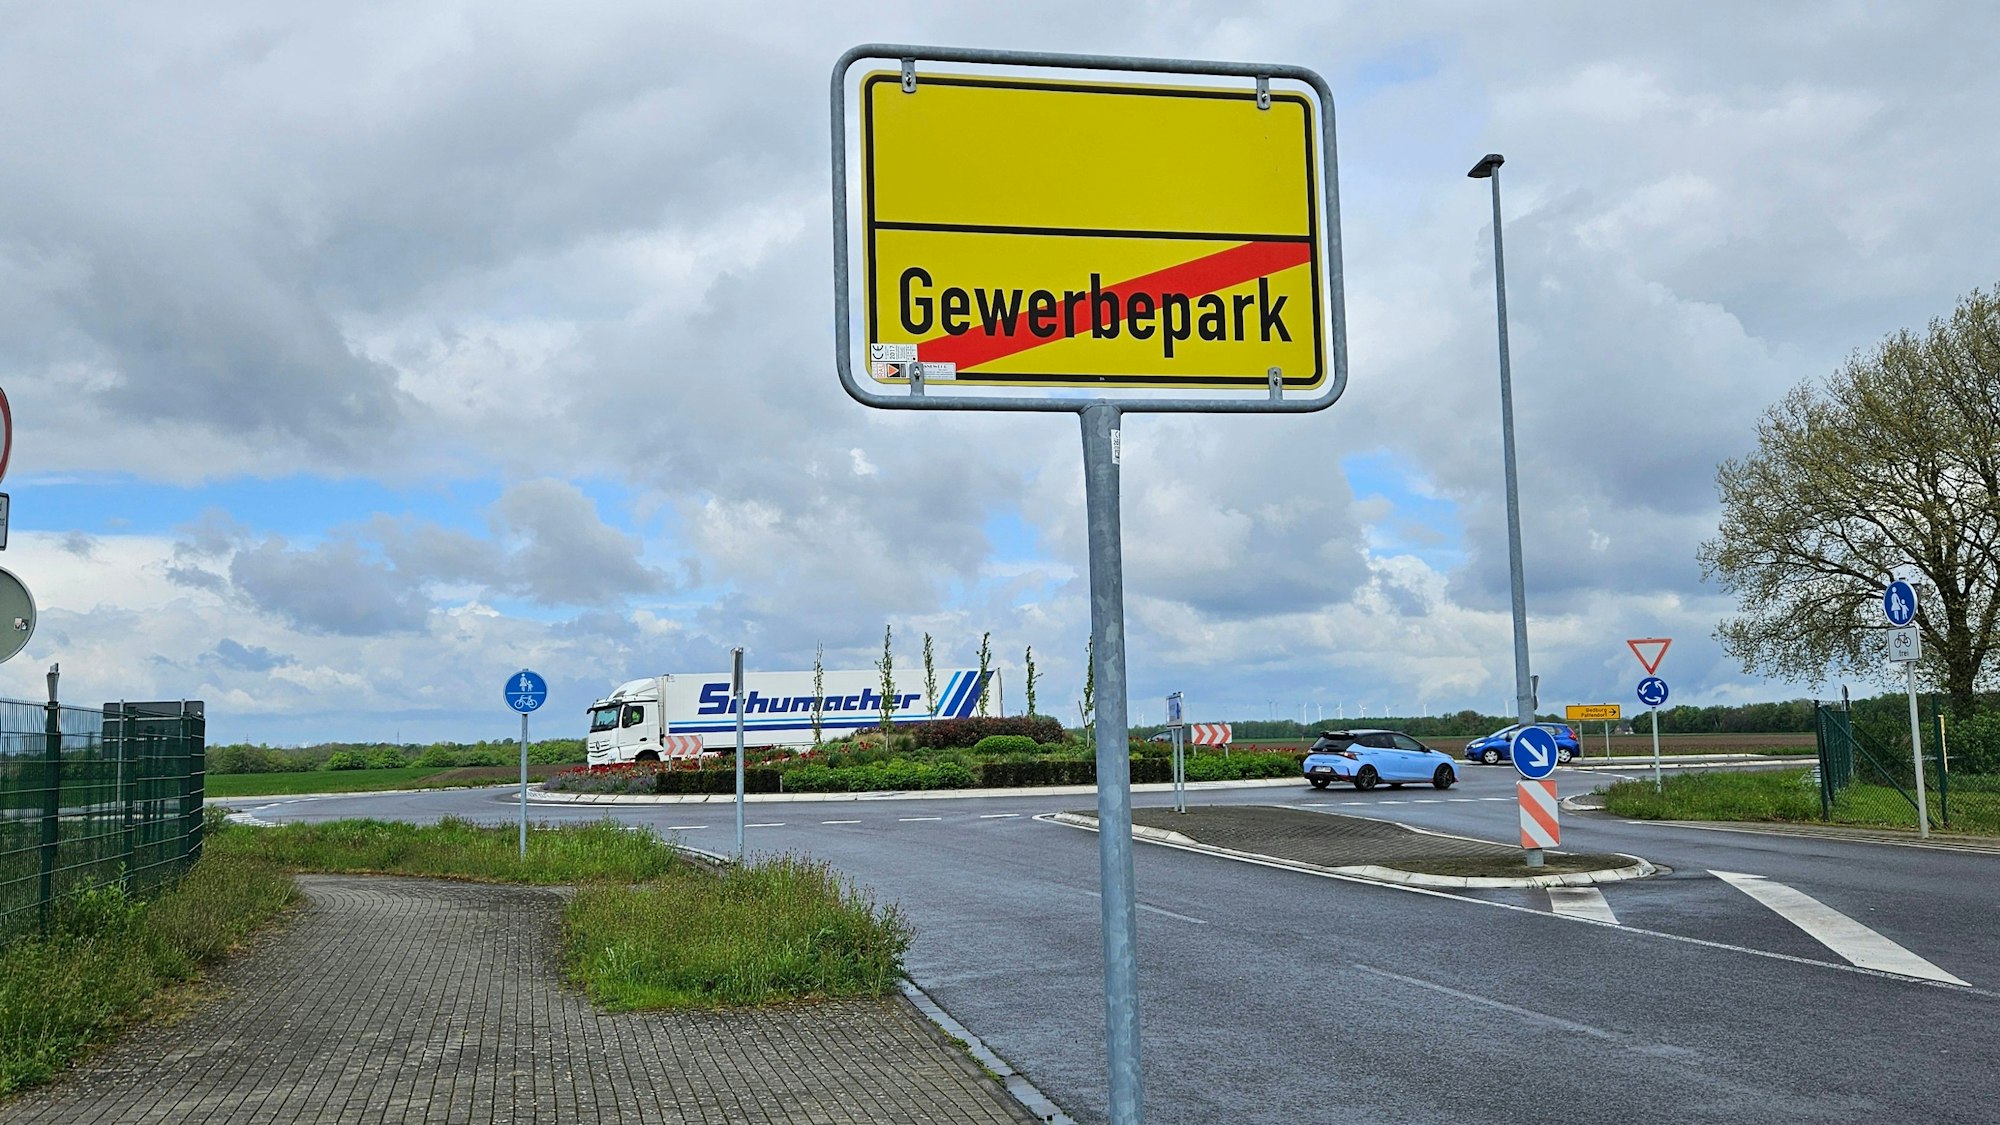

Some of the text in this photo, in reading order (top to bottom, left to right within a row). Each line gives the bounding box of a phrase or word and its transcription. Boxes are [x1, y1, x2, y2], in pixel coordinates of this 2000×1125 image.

[899, 267, 1292, 358] Gewerbepark
[1899, 649, 1909, 657] frei
[697, 682, 921, 715] Schumacher
